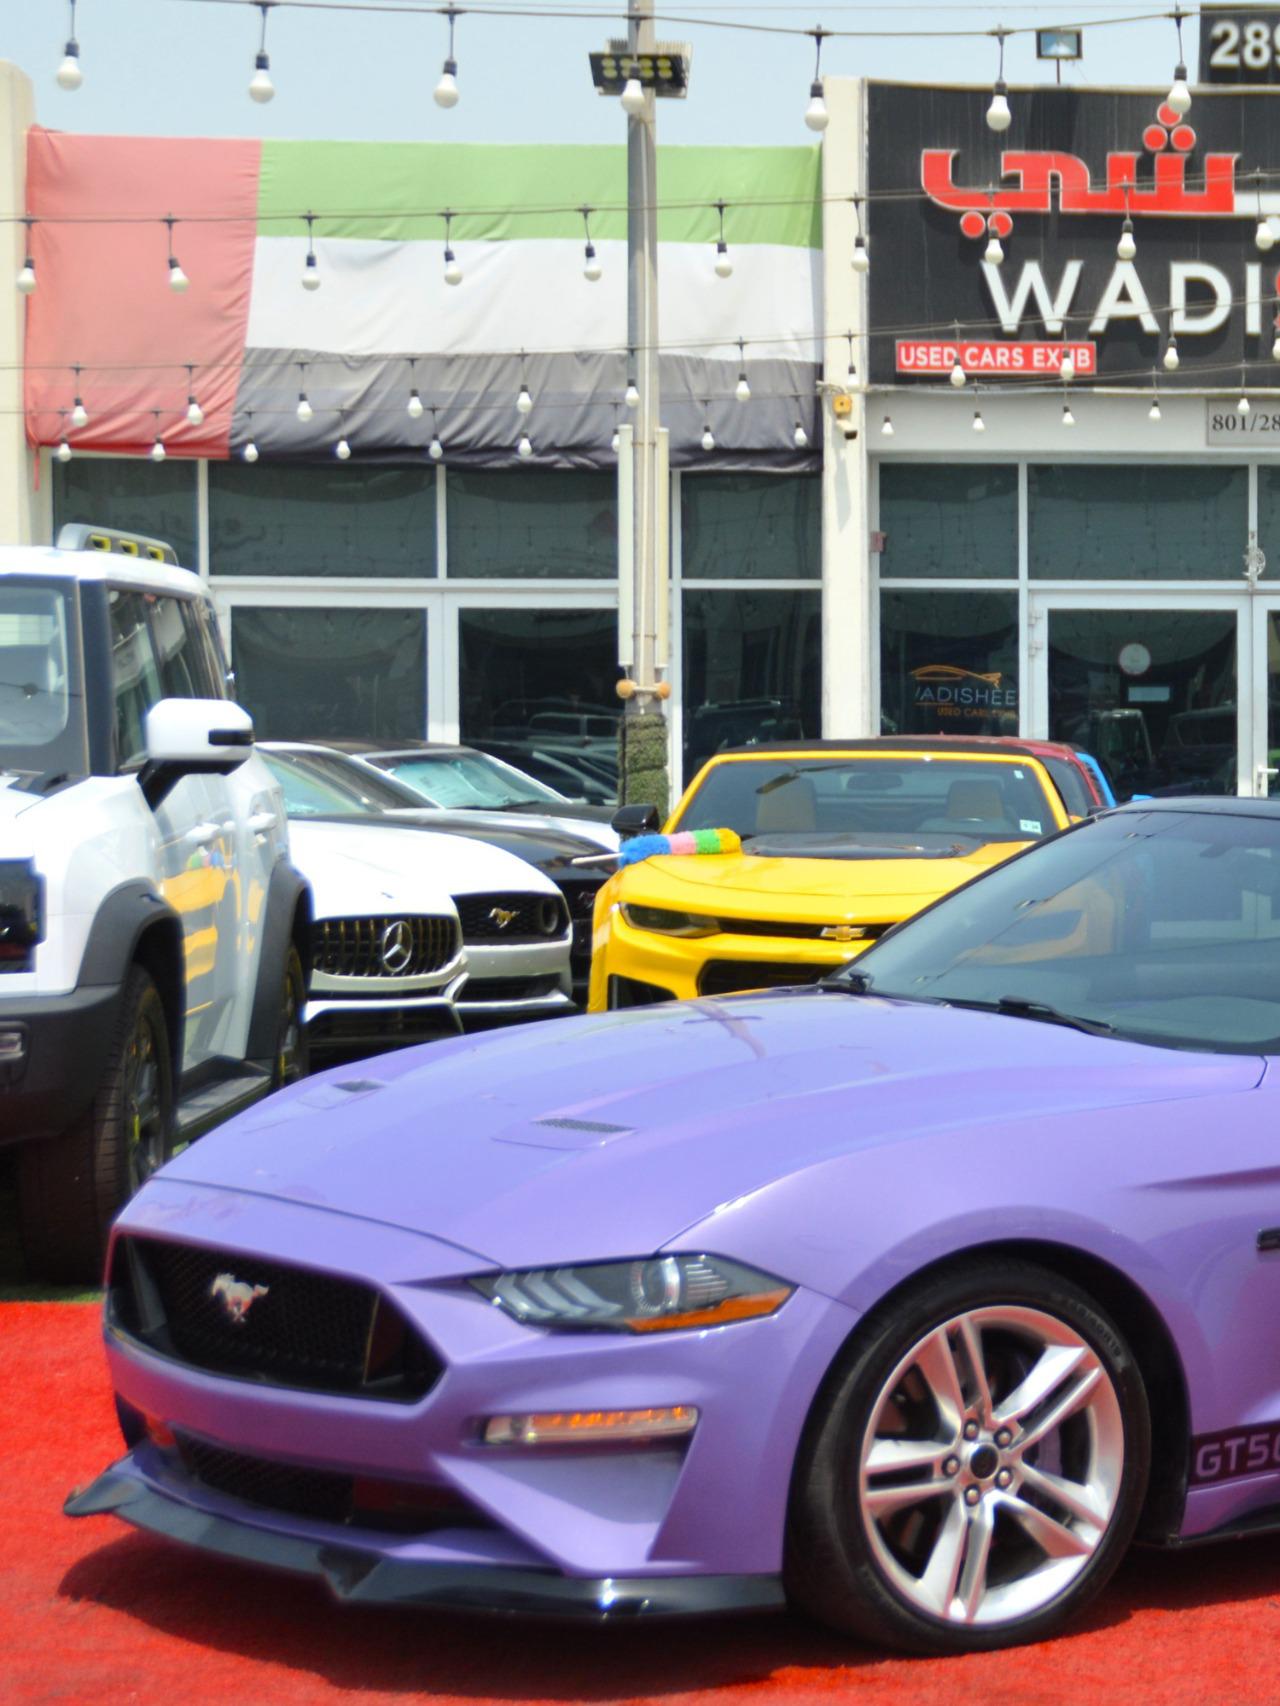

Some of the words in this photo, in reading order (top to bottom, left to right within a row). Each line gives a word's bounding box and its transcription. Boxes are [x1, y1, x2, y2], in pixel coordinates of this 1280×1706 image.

[900, 346, 958, 367] USED
[965, 347, 1024, 367] CARS
[914, 686, 1017, 705] ADISHEE
